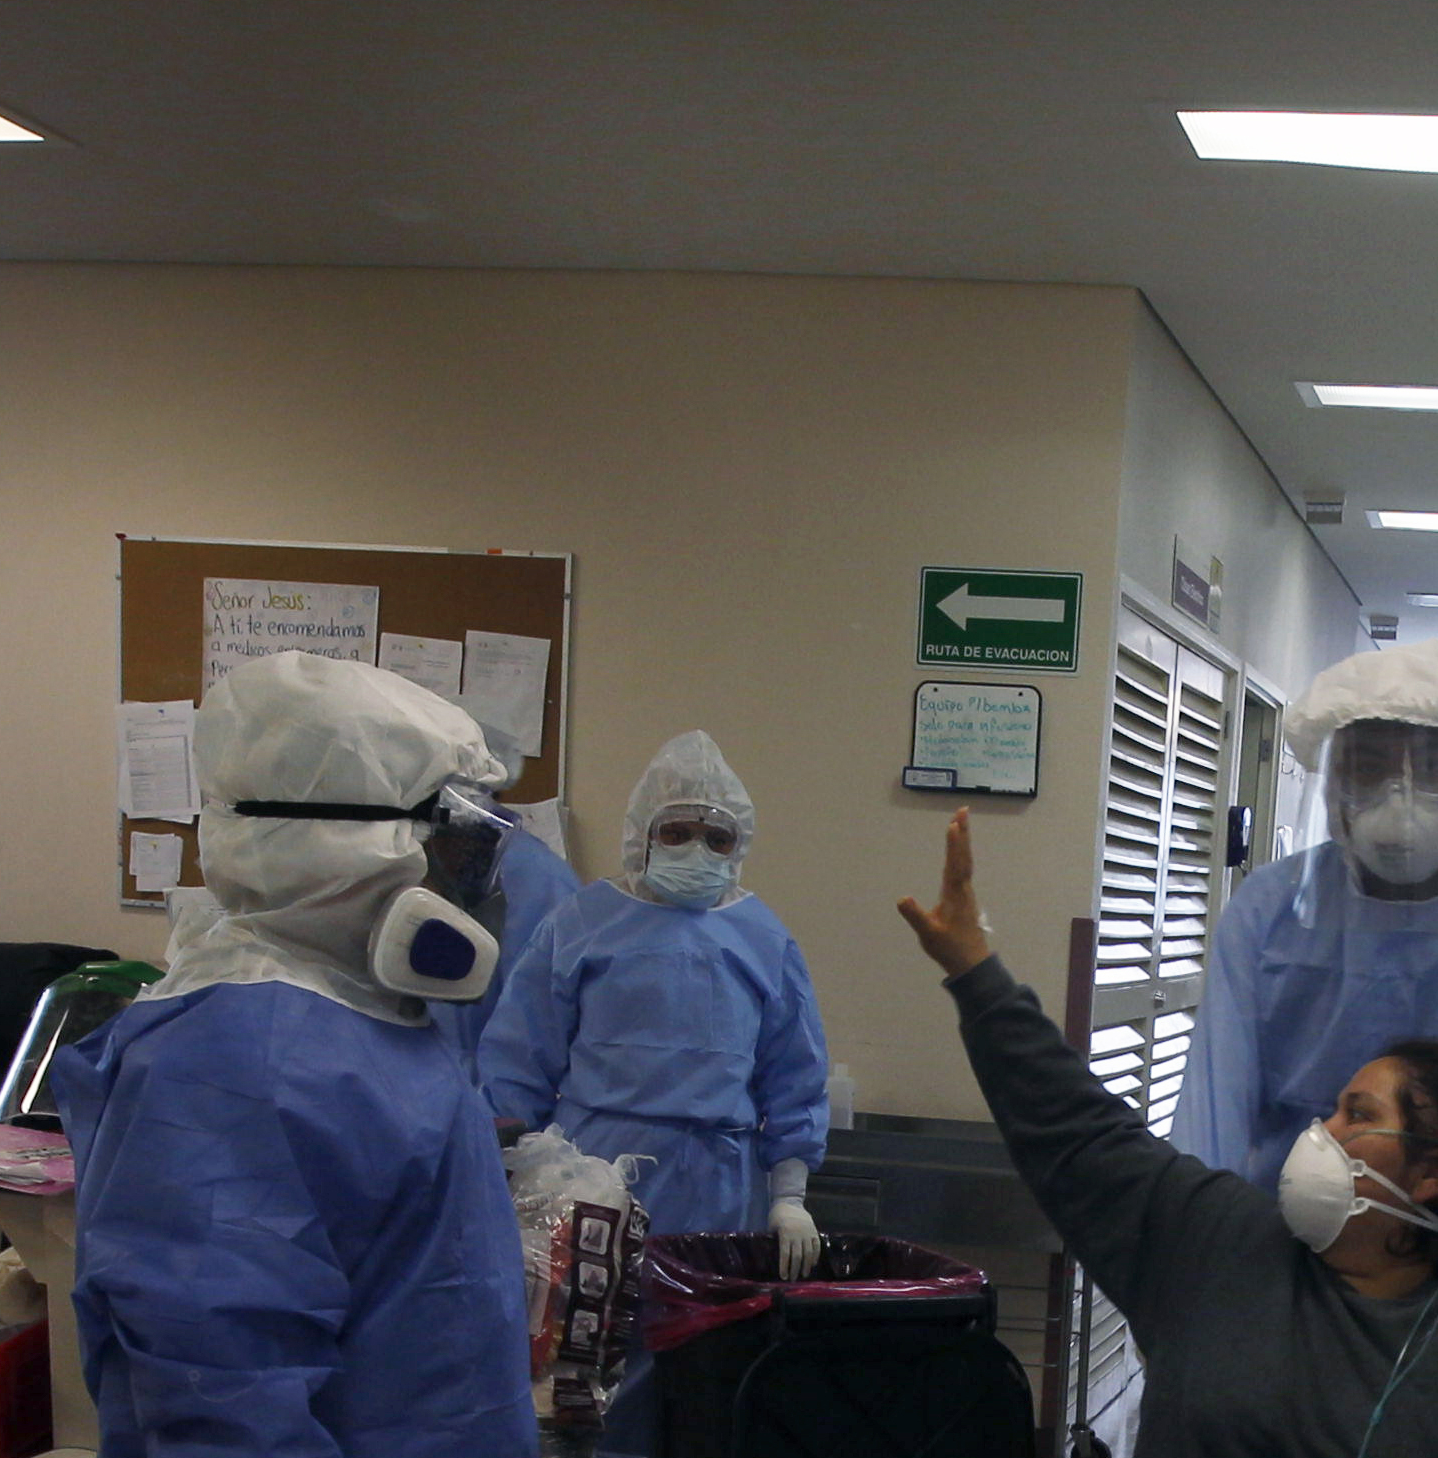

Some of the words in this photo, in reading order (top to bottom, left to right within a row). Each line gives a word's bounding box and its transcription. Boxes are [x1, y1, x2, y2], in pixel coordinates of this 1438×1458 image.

[213, 613, 225, 635] A
[247, 613, 262, 636] te
[267, 618, 366, 638] encomendamos
[925, 644, 961, 657] RUTA
[963, 646, 982, 658] DE
[985, 647, 1069, 662] EVACUACION
